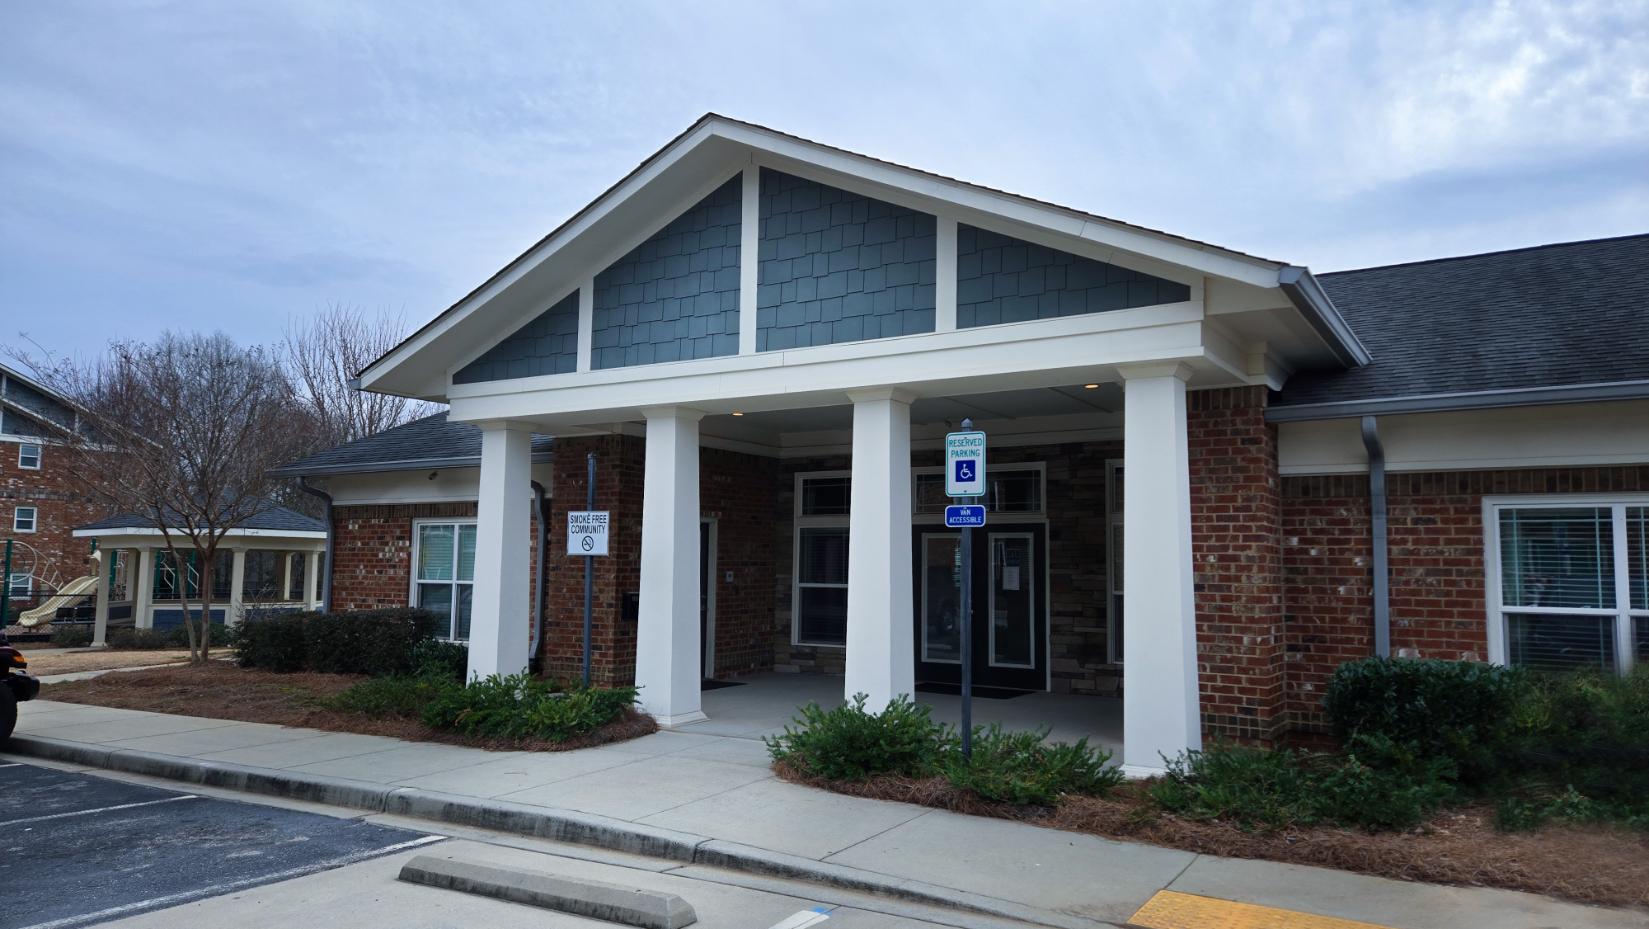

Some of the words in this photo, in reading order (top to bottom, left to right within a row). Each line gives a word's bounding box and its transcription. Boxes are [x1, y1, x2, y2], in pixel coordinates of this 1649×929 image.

[949, 438, 982, 447] RESERVED
[951, 449, 980, 458] PARKING
[570, 514, 590, 524] SMOKE
[592, 514, 606, 524] FREE
[571, 524, 606, 534] COMMUNITY
